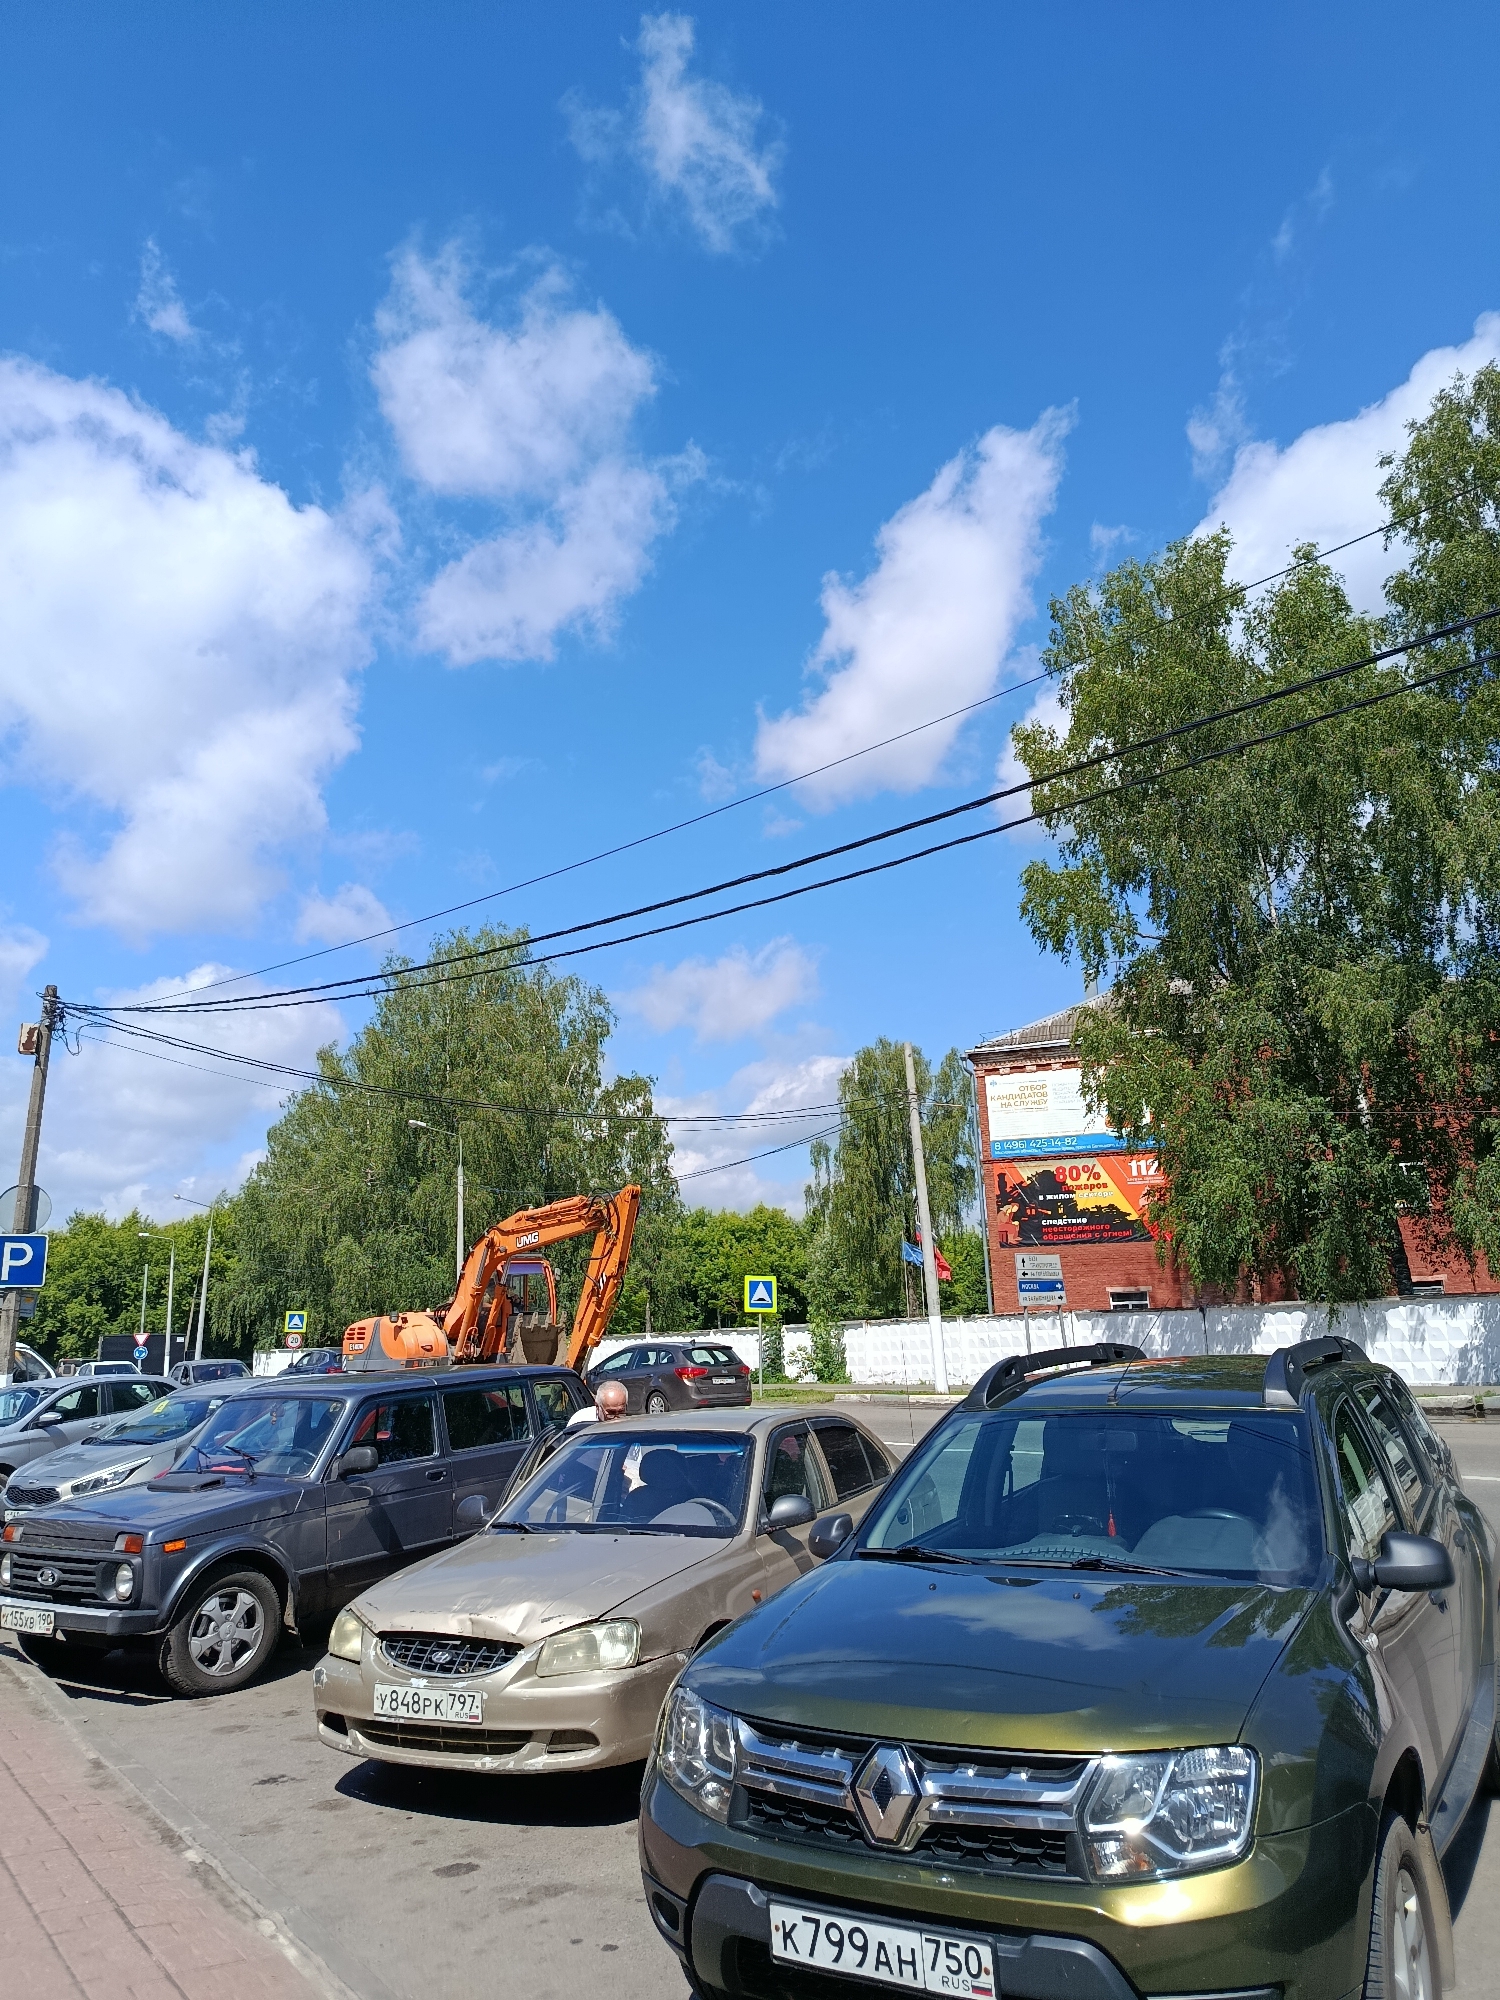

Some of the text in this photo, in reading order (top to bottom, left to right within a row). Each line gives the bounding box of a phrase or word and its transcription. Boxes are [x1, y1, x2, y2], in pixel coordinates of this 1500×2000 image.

[1019, 1084, 1048, 1092] ОТБОР
[990, 1091, 1048, 1102] КАНДИДАТОВ
[1000, 1099, 1048, 1109] НА СЛУЖБУ
[994, 1142, 1001, 1150] 8
[1004, 1140, 1027, 1150] (496)
[1030, 1137, 1078, 1148] 425-14-82
[1054, 1164, 1101, 1182] 80%
[1128, 1158, 1160, 1177] 112
[1061, 1182, 1108, 1191] пожаров
[1042, 1218, 1088, 1226] следствие
[1042, 1224, 1110, 1233] неосторожного
[516, 1231, 539, 1248] UMG
[1042, 1231, 1093, 1241] обращения
[1102, 1229, 1133, 1238] огнем!
[1, 1242, 34, 1281] P
[290, 1336, 299, 1344] 20
[448, 1692, 476, 1711] 797
[924, 1937, 983, 1980] 750
[941, 1975, 970, 1992] RUS
